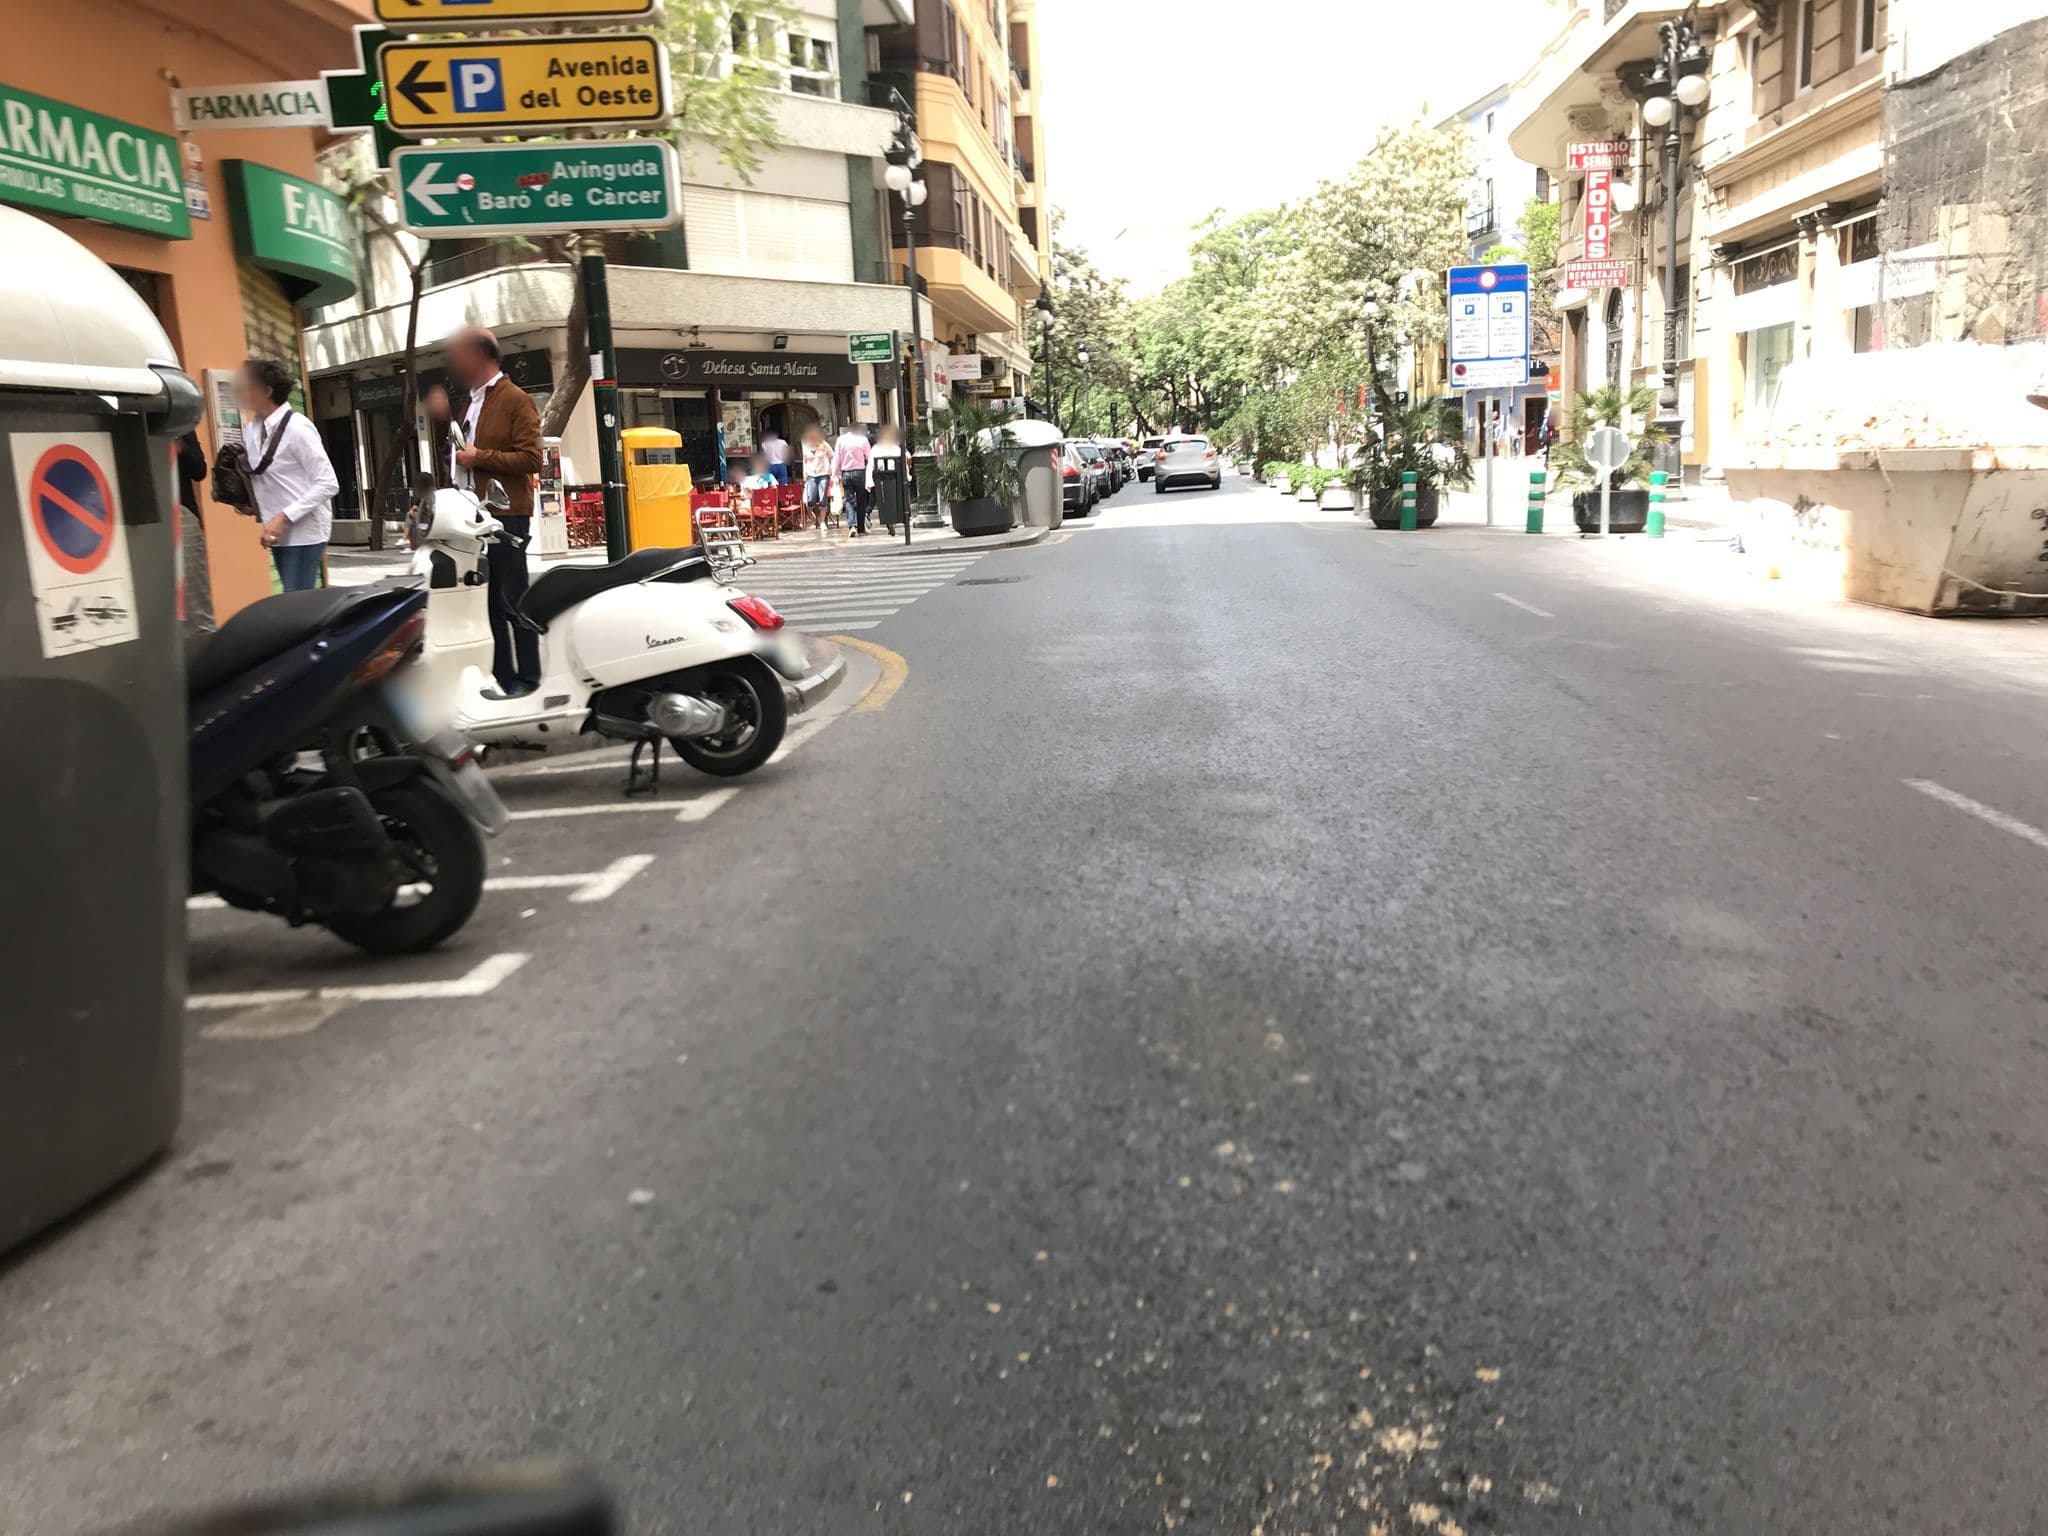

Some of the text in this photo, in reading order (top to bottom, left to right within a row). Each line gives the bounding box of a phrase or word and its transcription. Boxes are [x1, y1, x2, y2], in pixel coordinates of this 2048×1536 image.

[547, 56, 650, 79] Avenida
[459, 63, 496, 108] P
[519, 84, 653, 109] del Oeste
[188, 91, 320, 120] FARMACIA
[0, 99, 182, 193] RMACIA
[1570, 141, 1629, 155] ESTUDIO
[552, 160, 660, 182] Avinguda
[71, 182, 173, 223] MAGISTRALES
[477, 186, 663, 210] Baró de Càrcer
[1588, 171, 1608, 258] FOTOS
[1568, 260, 1626, 270] INDUSTRIALES
[1568, 269, 1624, 280] REPORTAJES
[702, 358, 746, 375] Dehesa
[747, 361, 782, 377] Santa
[646, 634, 687, 649] Vespa
